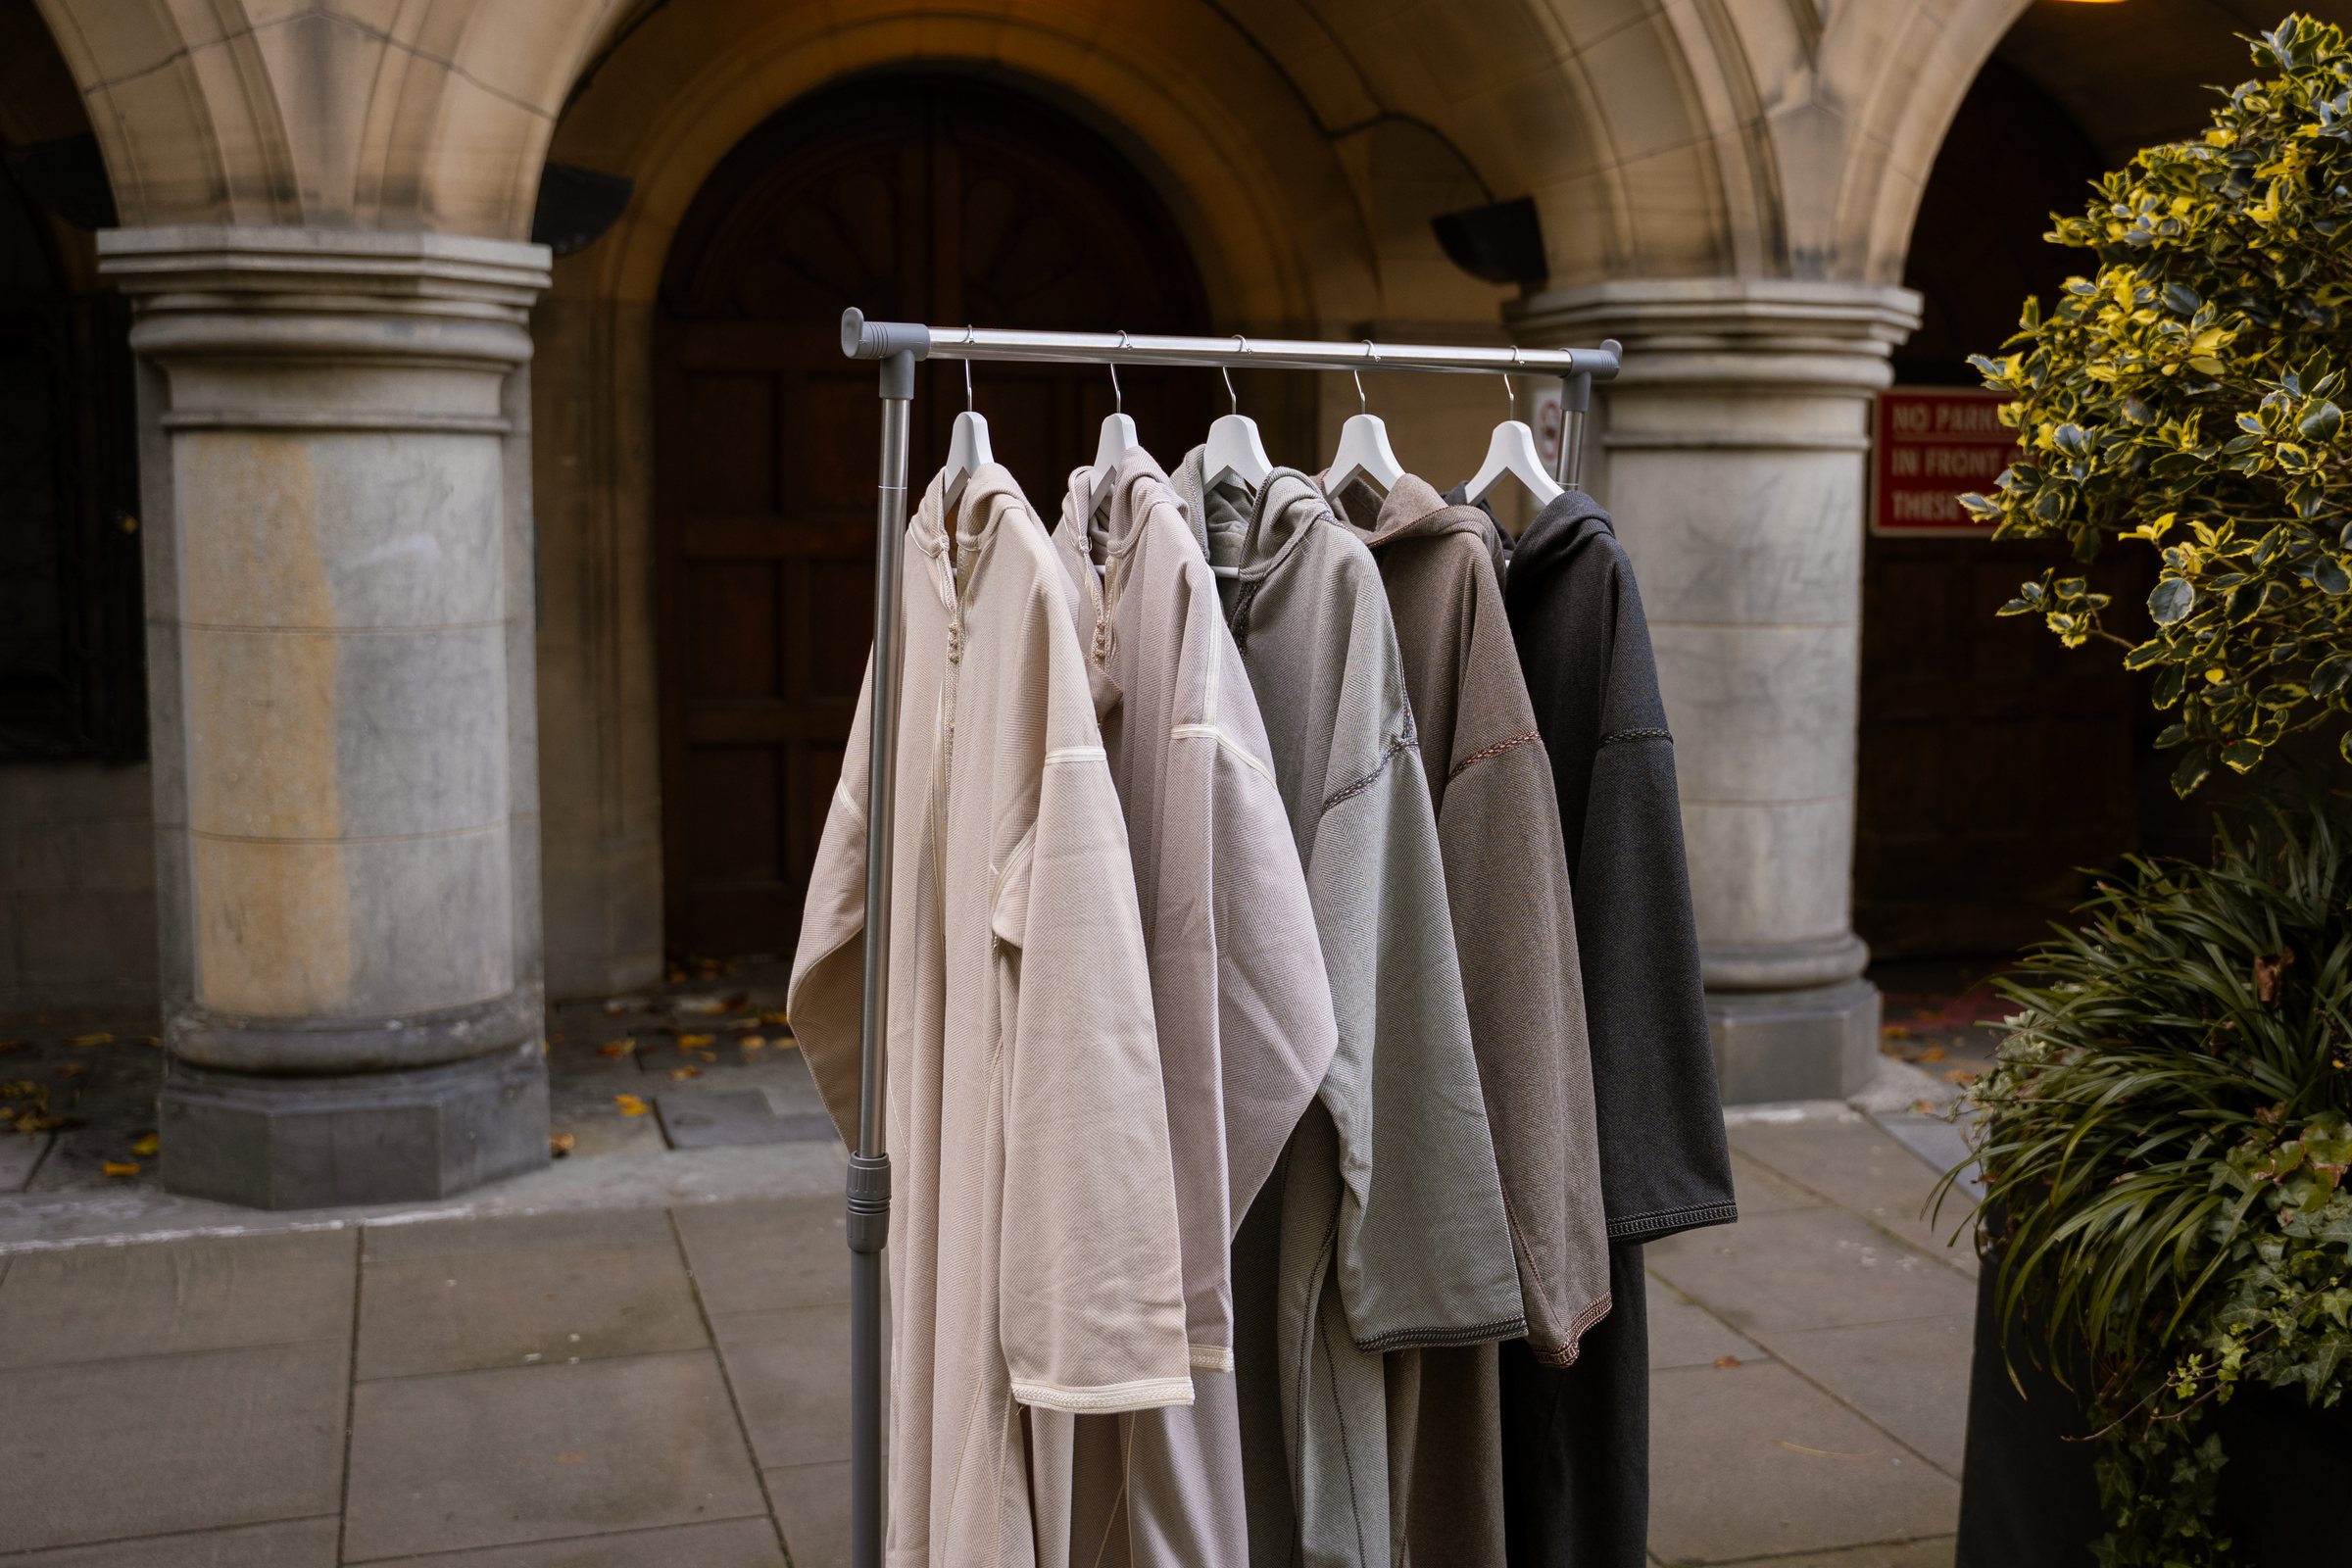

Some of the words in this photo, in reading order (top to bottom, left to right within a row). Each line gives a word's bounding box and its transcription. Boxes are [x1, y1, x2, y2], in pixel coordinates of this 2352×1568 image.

[1891, 403, 1931, 431] NO
[1891, 447, 1918, 477] IN
[1924, 447, 2000, 478] FRONT
